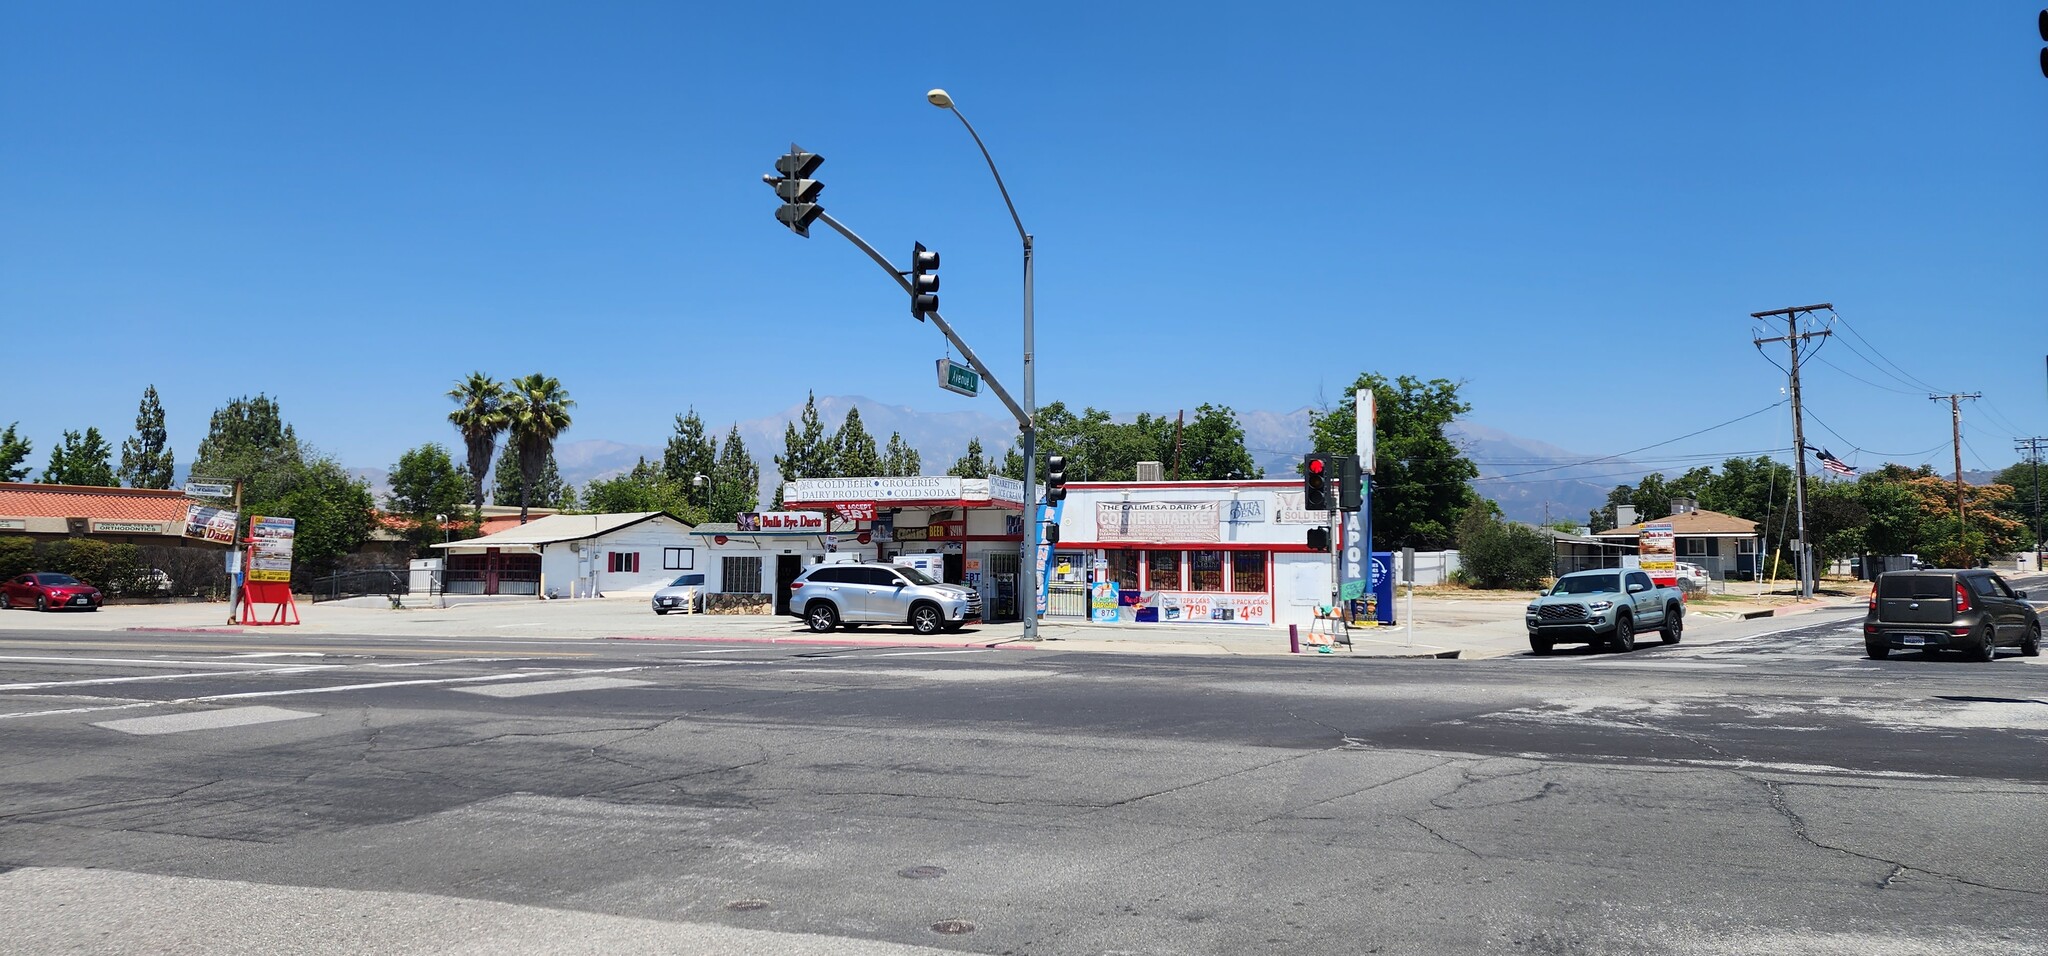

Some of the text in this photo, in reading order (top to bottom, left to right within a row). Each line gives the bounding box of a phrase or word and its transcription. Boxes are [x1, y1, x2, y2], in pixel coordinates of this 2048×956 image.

[817, 481, 845, 489] COLD
[847, 480, 872, 488] BEER
[882, 479, 940, 487] GROCERIES
[802, 489, 956, 499] DAIRY PRODUCTS COLD SODAS
[1235, 501, 1260, 510] ALTA
[840, 509, 874, 519] EBT
[1100, 511, 1216, 525] CORNER MARKET
[1230, 508, 1262, 519] DENA
[1284, 511, 1310, 520] SOLD
[762, 514, 822, 530] Bulls Eye Darts
[207, 528, 233, 542] Darts
[929, 525, 944, 537] BEER
[1124, 595, 1139, 603] Red
[1101, 609, 1115, 617] 875
